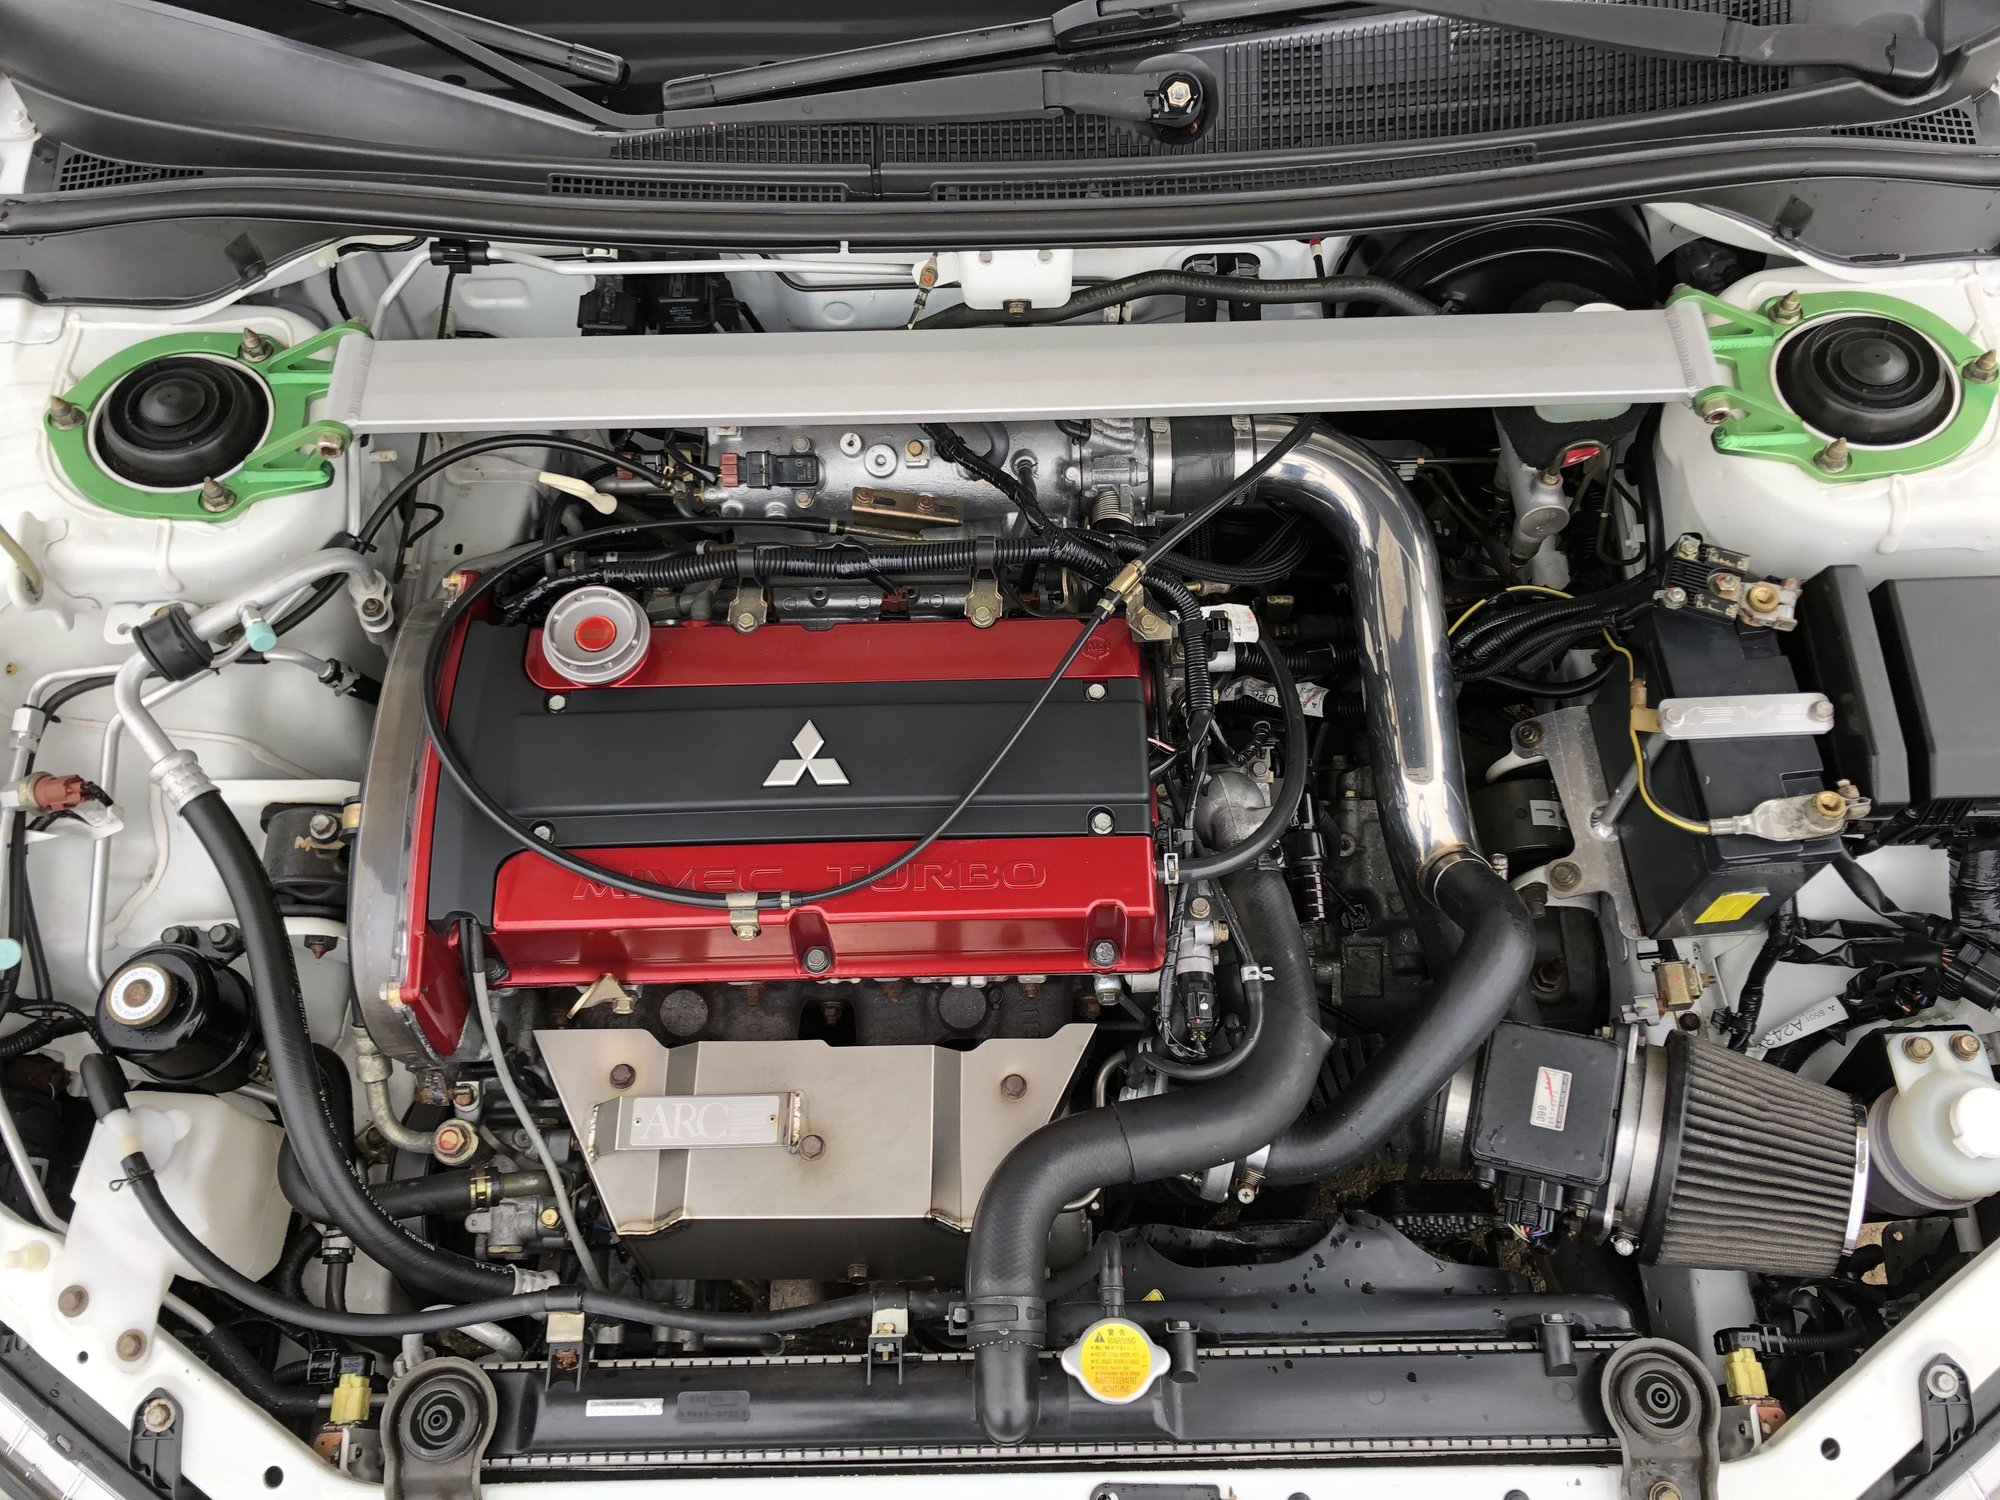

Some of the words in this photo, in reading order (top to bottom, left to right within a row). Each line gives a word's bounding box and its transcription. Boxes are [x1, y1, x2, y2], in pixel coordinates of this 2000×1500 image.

[826, 859, 1047, 891] TURBO
[639, 1102, 729, 1140] ARC
[1107, 1337, 1136, 1345] WARNING
